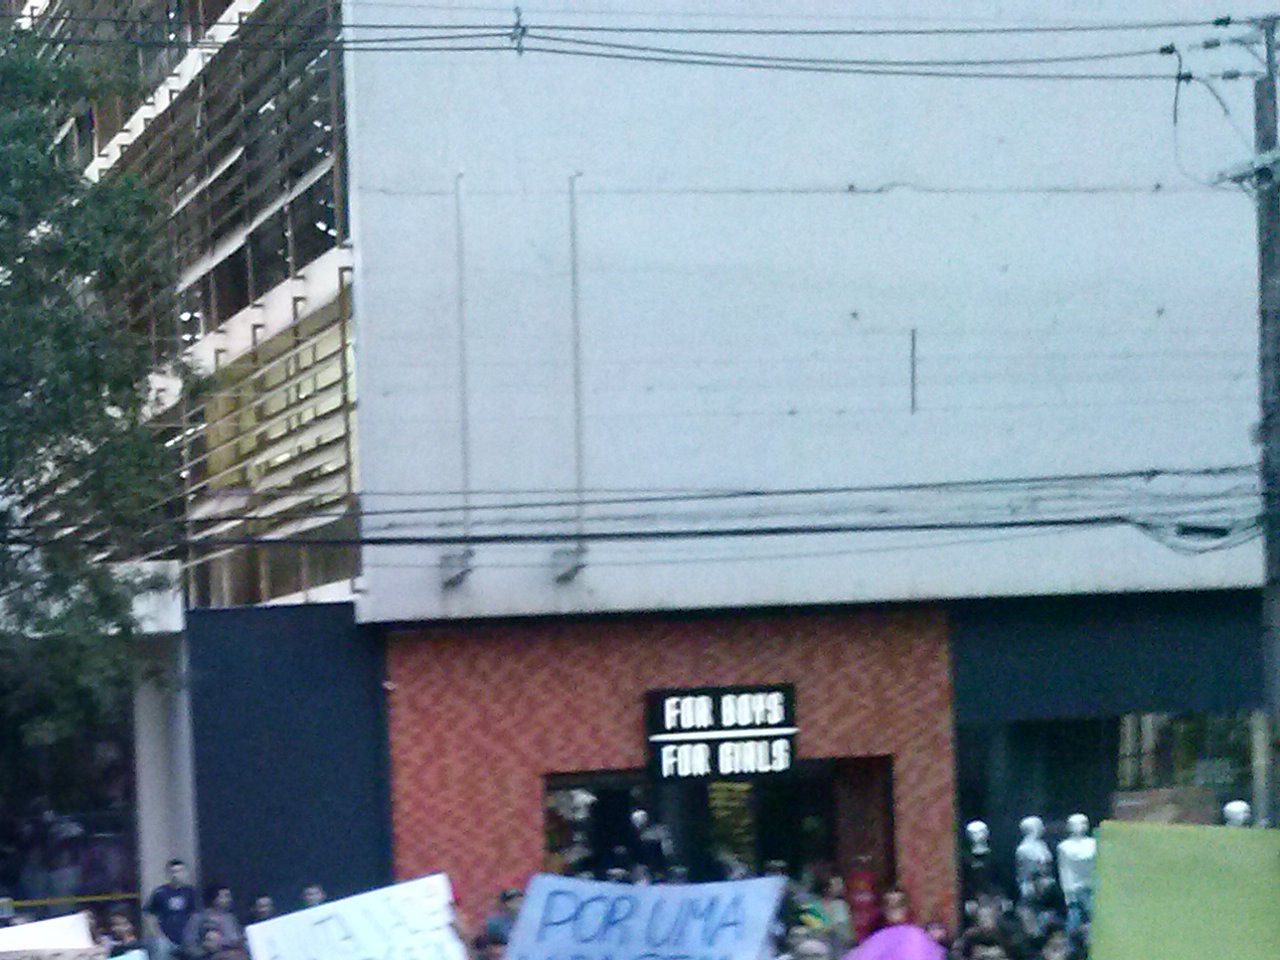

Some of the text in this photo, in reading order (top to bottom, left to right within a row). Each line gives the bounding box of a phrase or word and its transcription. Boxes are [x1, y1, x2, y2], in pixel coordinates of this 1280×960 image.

[664, 692, 785, 730] FOR BOYS
[661, 739, 790, 778] FOR GIRLS
[536, 889, 746, 949] POR UMA
